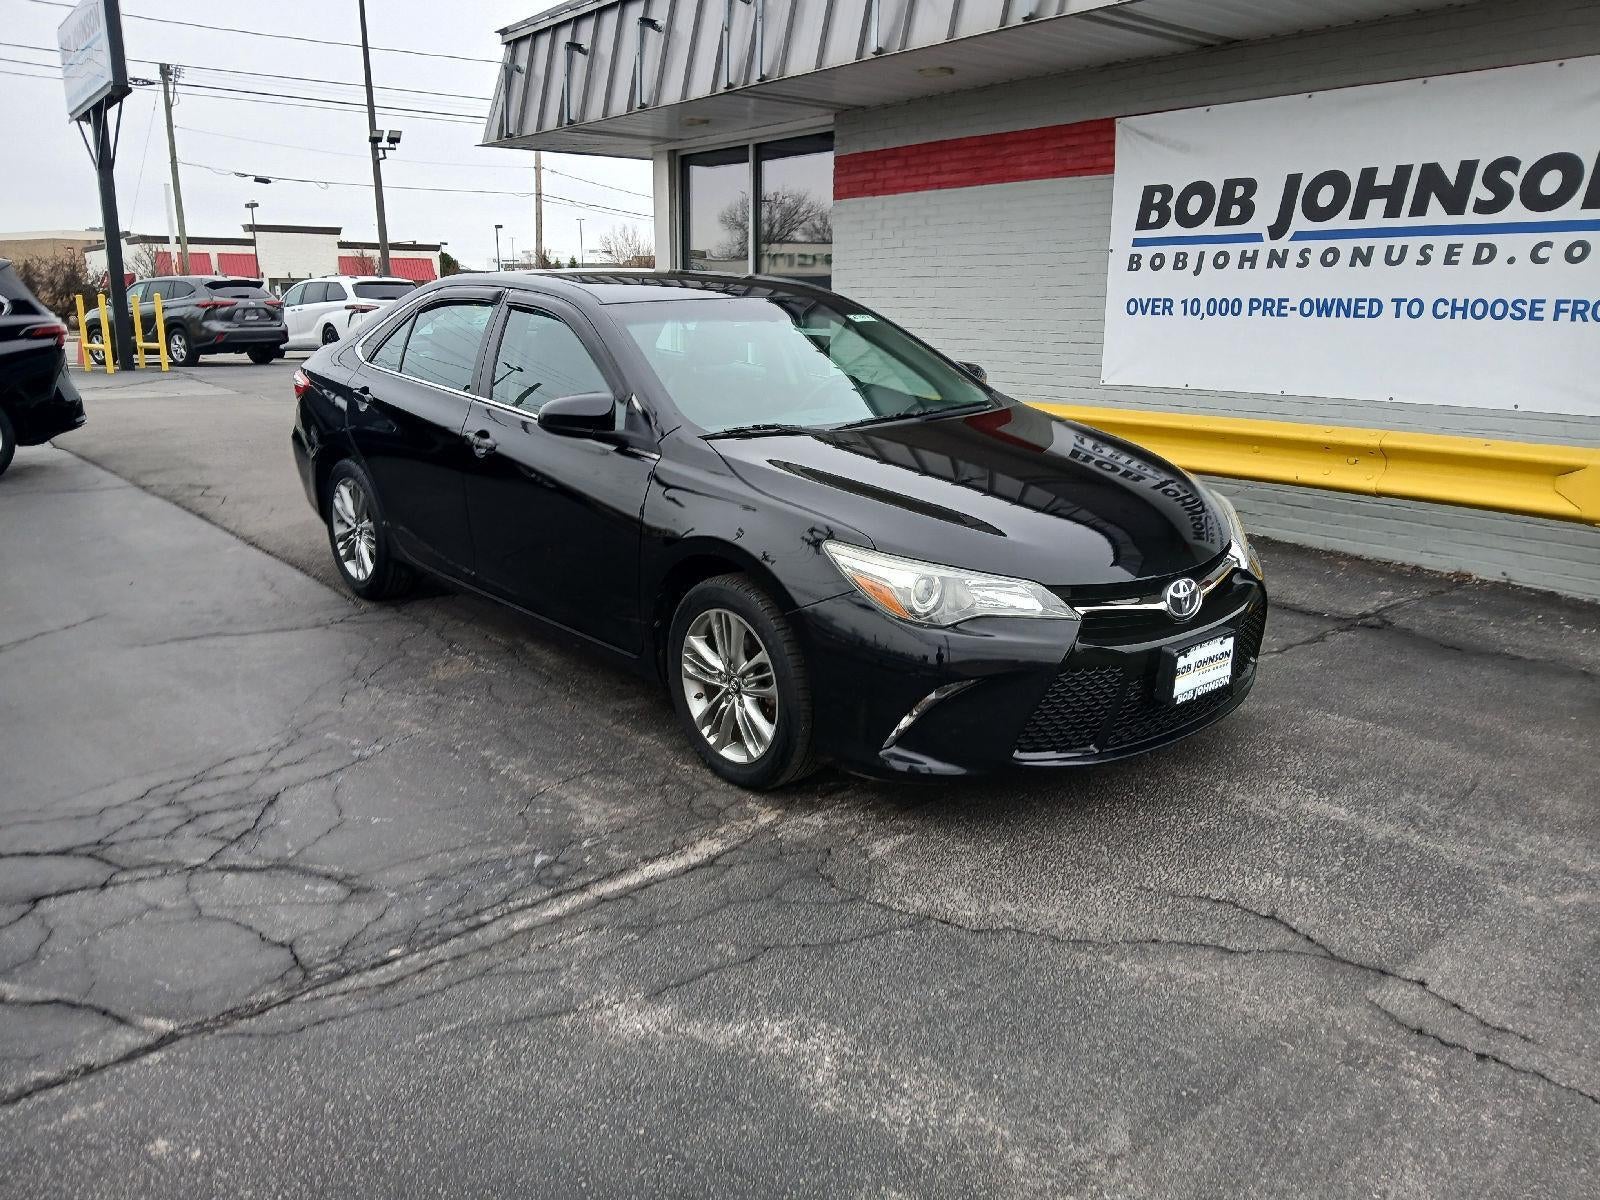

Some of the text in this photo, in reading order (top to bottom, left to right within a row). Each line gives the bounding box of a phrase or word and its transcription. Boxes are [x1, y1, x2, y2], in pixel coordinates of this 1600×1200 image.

[1135, 150, 1600, 240] BOB JOHNSO
[1126, 297, 1174, 316] OVER
[1180, 297, 1243, 320] 10,000
[1247, 297, 1383, 319] PRE-OWNED
[1391, 297, 1425, 319] TO
[1432, 297, 1546, 321] CHOOSE
[1176, 664, 1192, 677] BOB
[1192, 649, 1232, 674] JOHNSON
[1176, 675, 1230, 704] BOB JOHNSON
